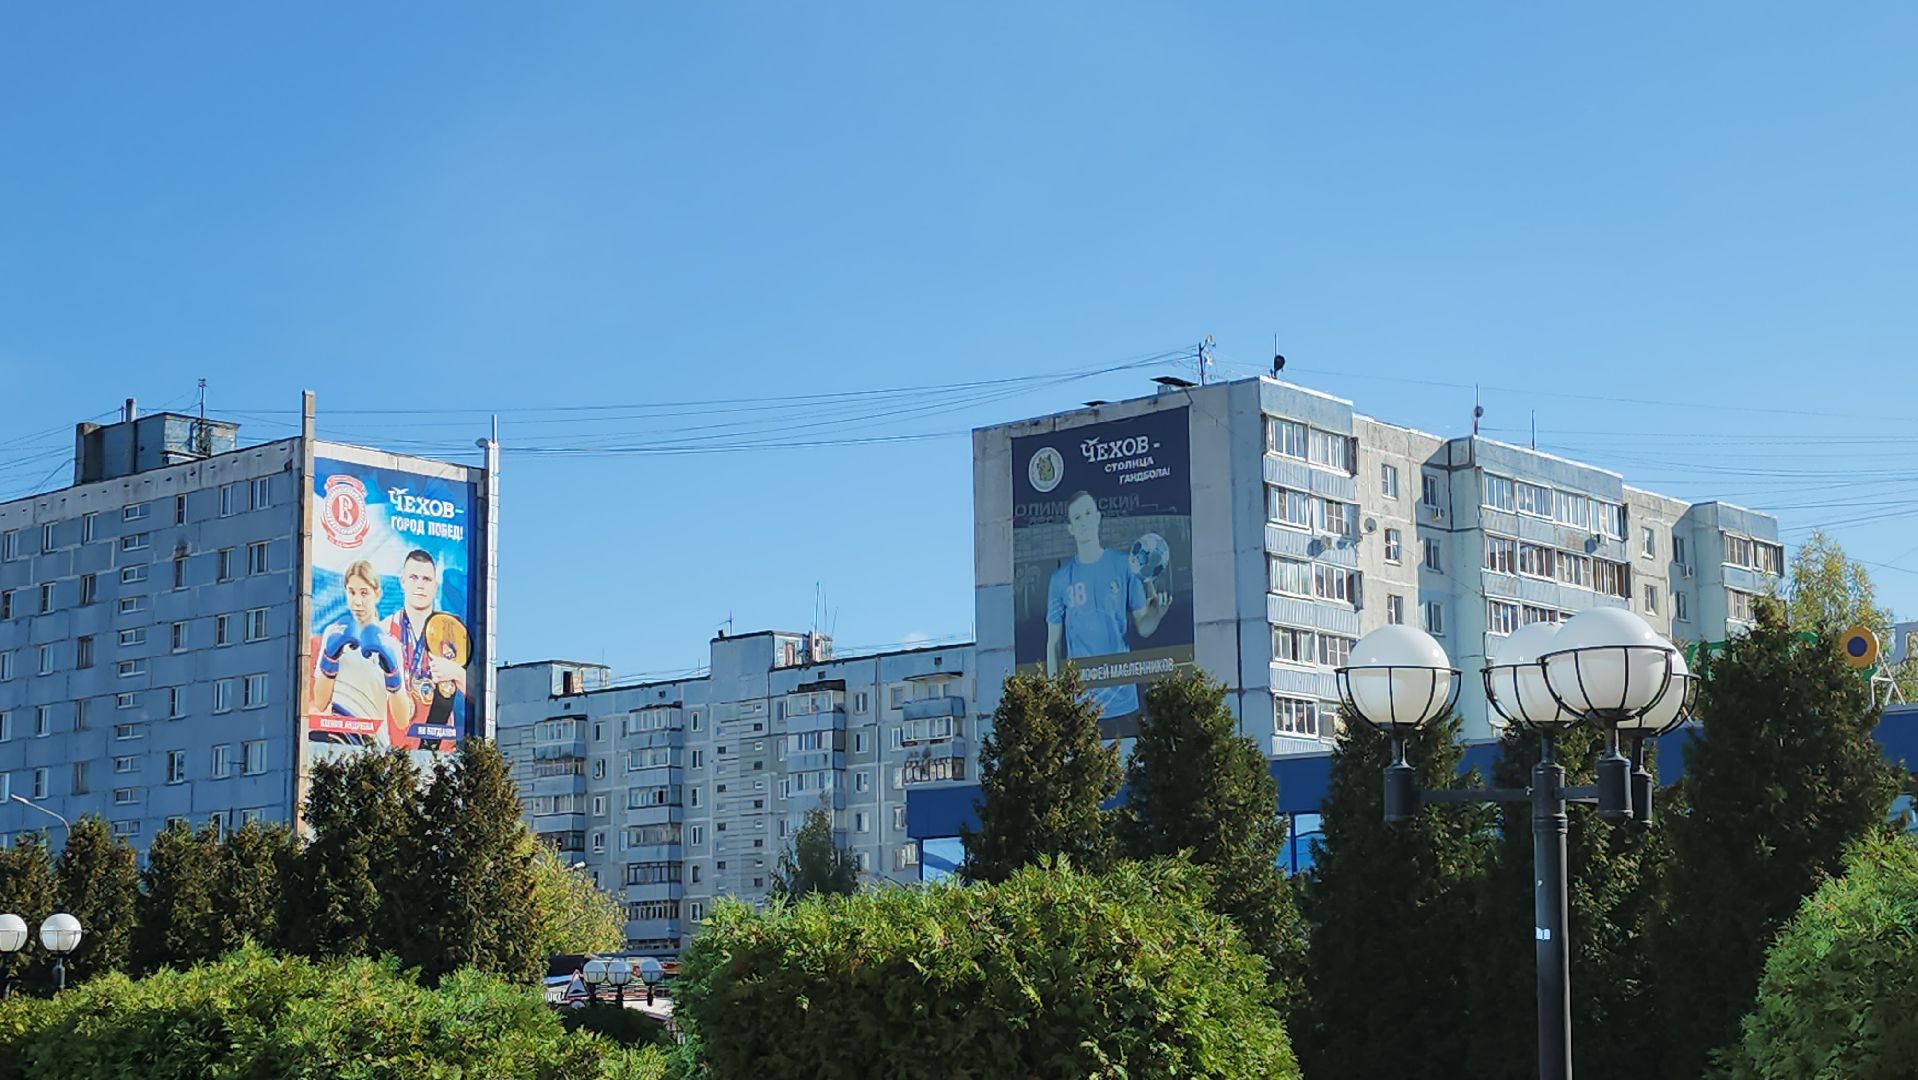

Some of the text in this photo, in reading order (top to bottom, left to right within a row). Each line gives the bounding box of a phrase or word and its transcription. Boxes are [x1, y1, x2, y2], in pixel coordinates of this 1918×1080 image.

[1080, 436, 1149, 463] ЧЕХОВ
[1104, 456, 1154, 473] СТОЛИЦА
[1119, 466, 1170, 484] ГАНДБОЛА!
[390, 515, 463, 541] ГОРОД ПОБЕД!
